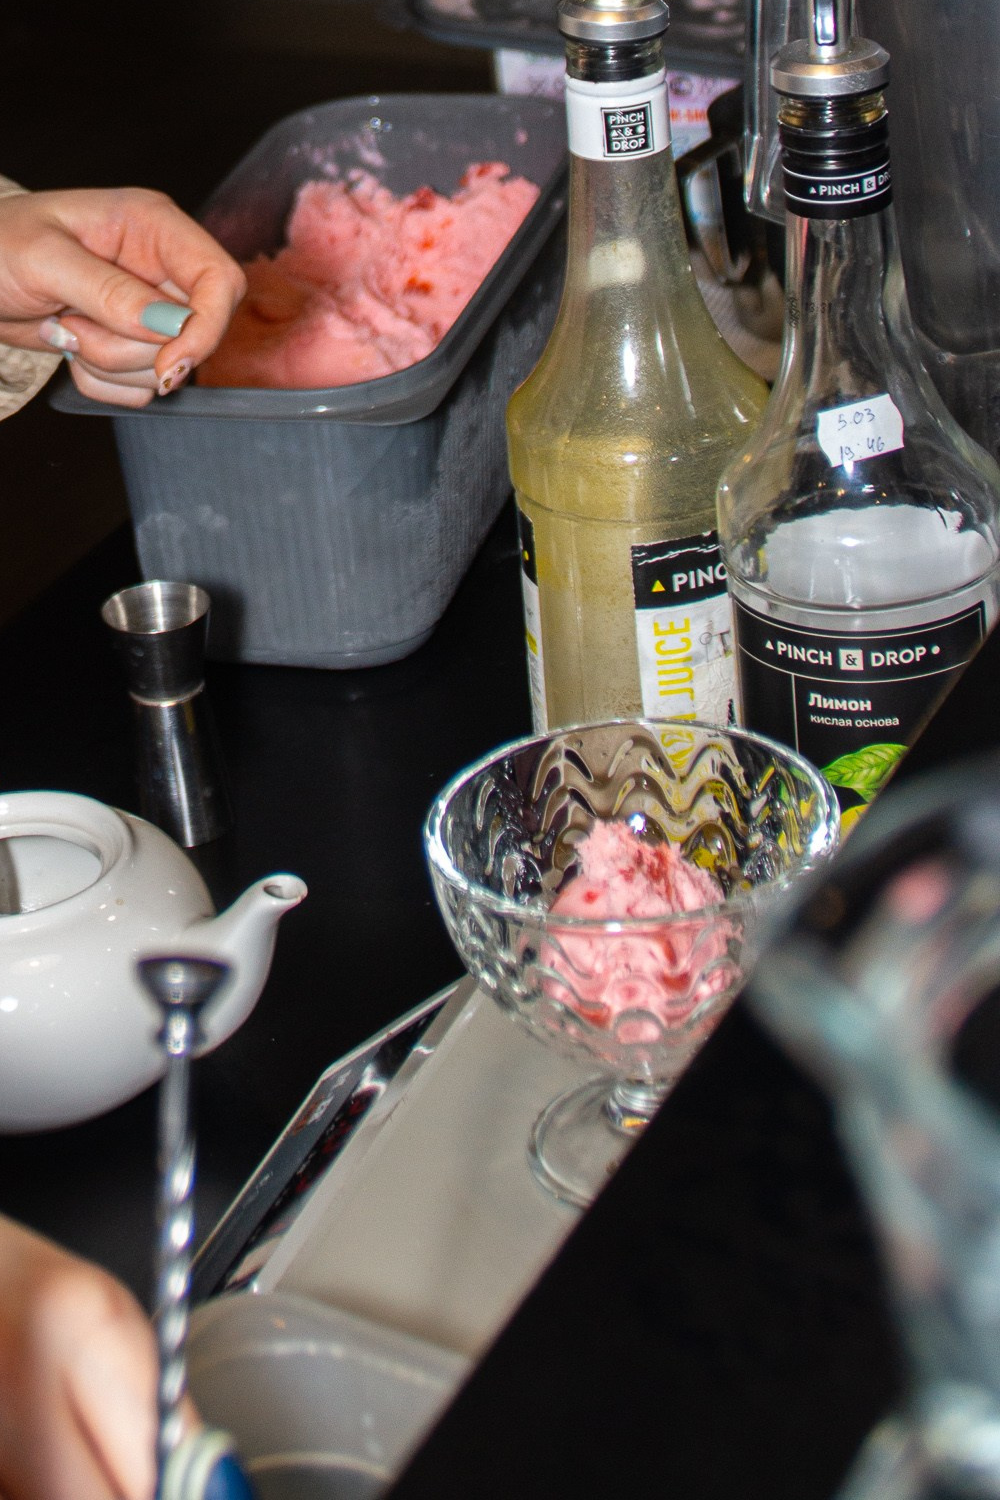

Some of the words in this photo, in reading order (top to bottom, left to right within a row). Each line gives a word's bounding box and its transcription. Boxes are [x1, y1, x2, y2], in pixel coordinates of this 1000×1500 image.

[609, 111, 645, 125] PINCH
[623, 127, 634, 136] &
[612, 137, 646, 151] DROP
[819, 182, 860, 196] PINCH
[671, 562, 729, 593] PINC
[653, 617, 695, 701] JUICE
[776, 640, 833, 666] PINCH
[845, 653, 858, 666] &
[870, 645, 927, 667] DROP
[808, 692, 872, 711] Лимон
[810, 714, 853, 727] кислая
[855, 716, 900, 727] основа
